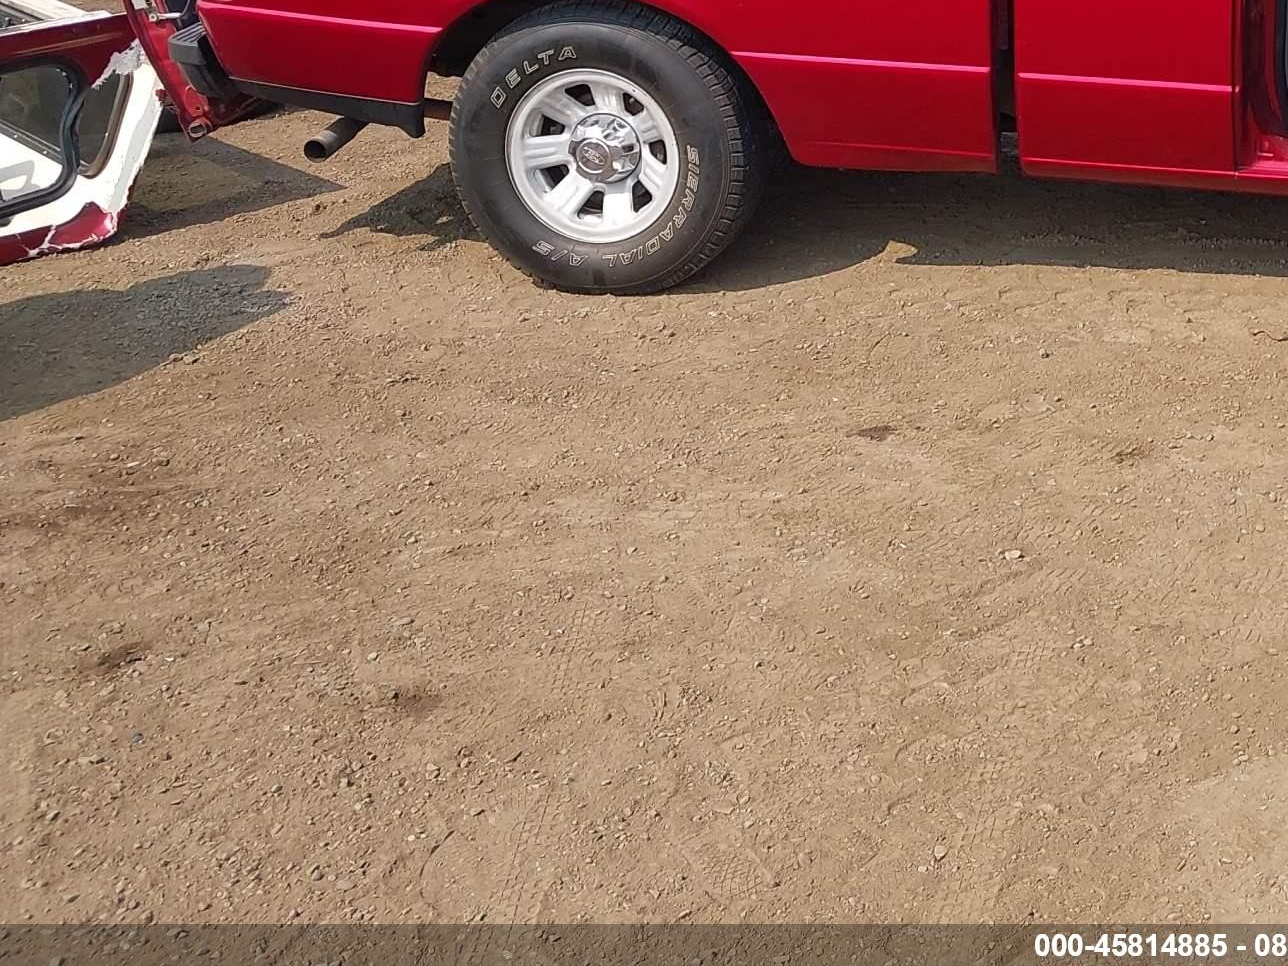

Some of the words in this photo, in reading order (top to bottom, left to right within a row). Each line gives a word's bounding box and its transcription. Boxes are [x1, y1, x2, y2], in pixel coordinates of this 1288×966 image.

[490, 45, 577, 109] DELTA
[602, 144, 701, 267] SIERRADIAL
[531, 240, 590, 267] A/S
